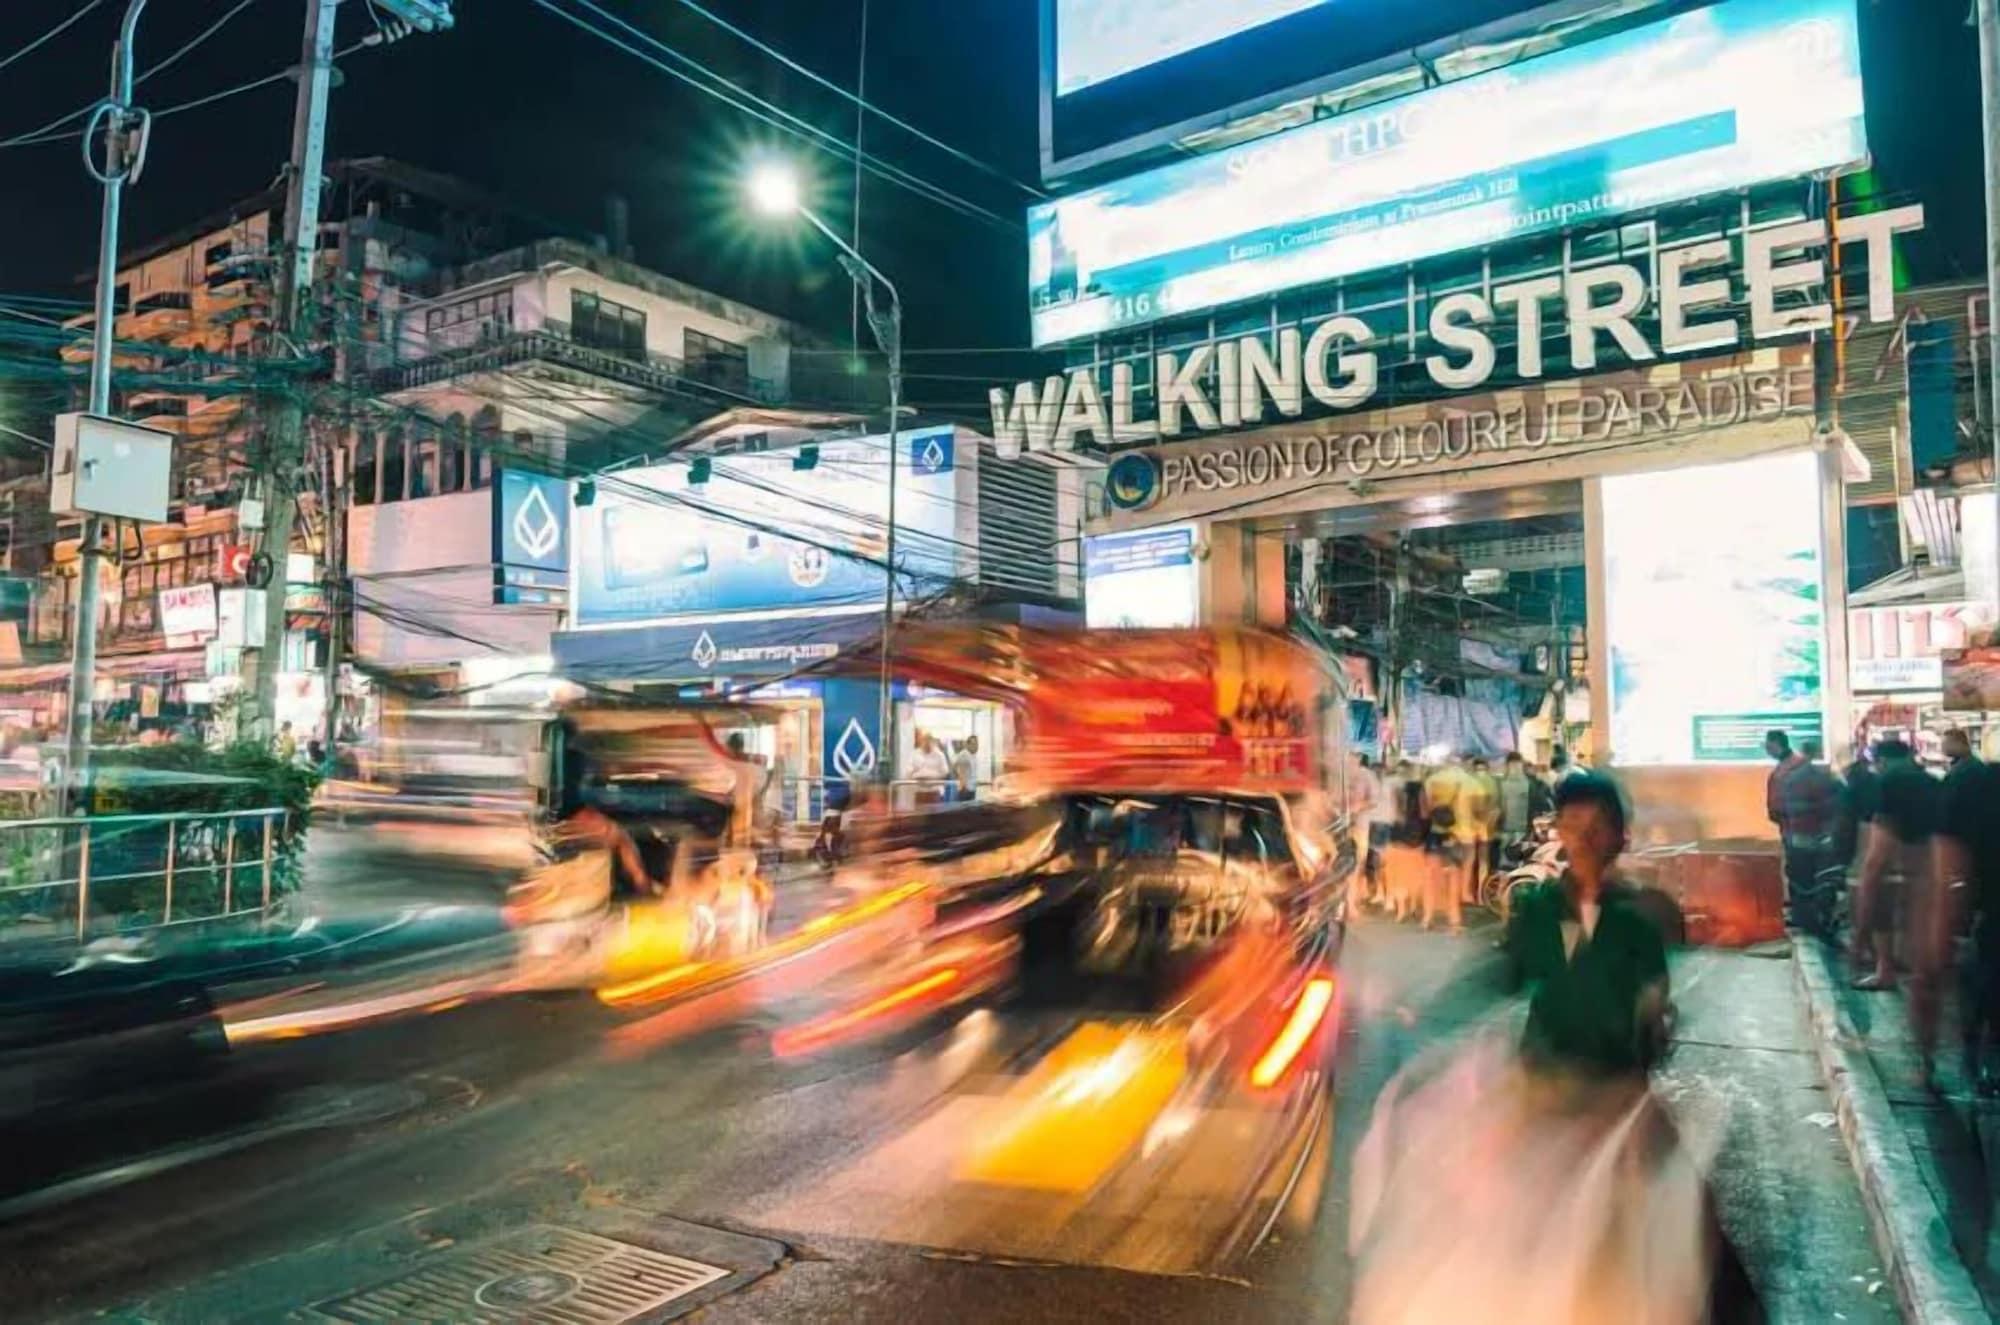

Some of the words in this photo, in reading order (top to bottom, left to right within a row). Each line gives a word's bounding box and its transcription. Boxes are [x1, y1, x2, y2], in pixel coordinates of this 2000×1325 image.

[988, 315, 1378, 461] WALKING
[1426, 204, 1924, 389] STREET
[1161, 440, 1293, 497] PASSION
[1300, 434, 1341, 475] OF
[1348, 400, 1581, 474] COLOURFUL
[1580, 366, 1814, 441] PARADISE
